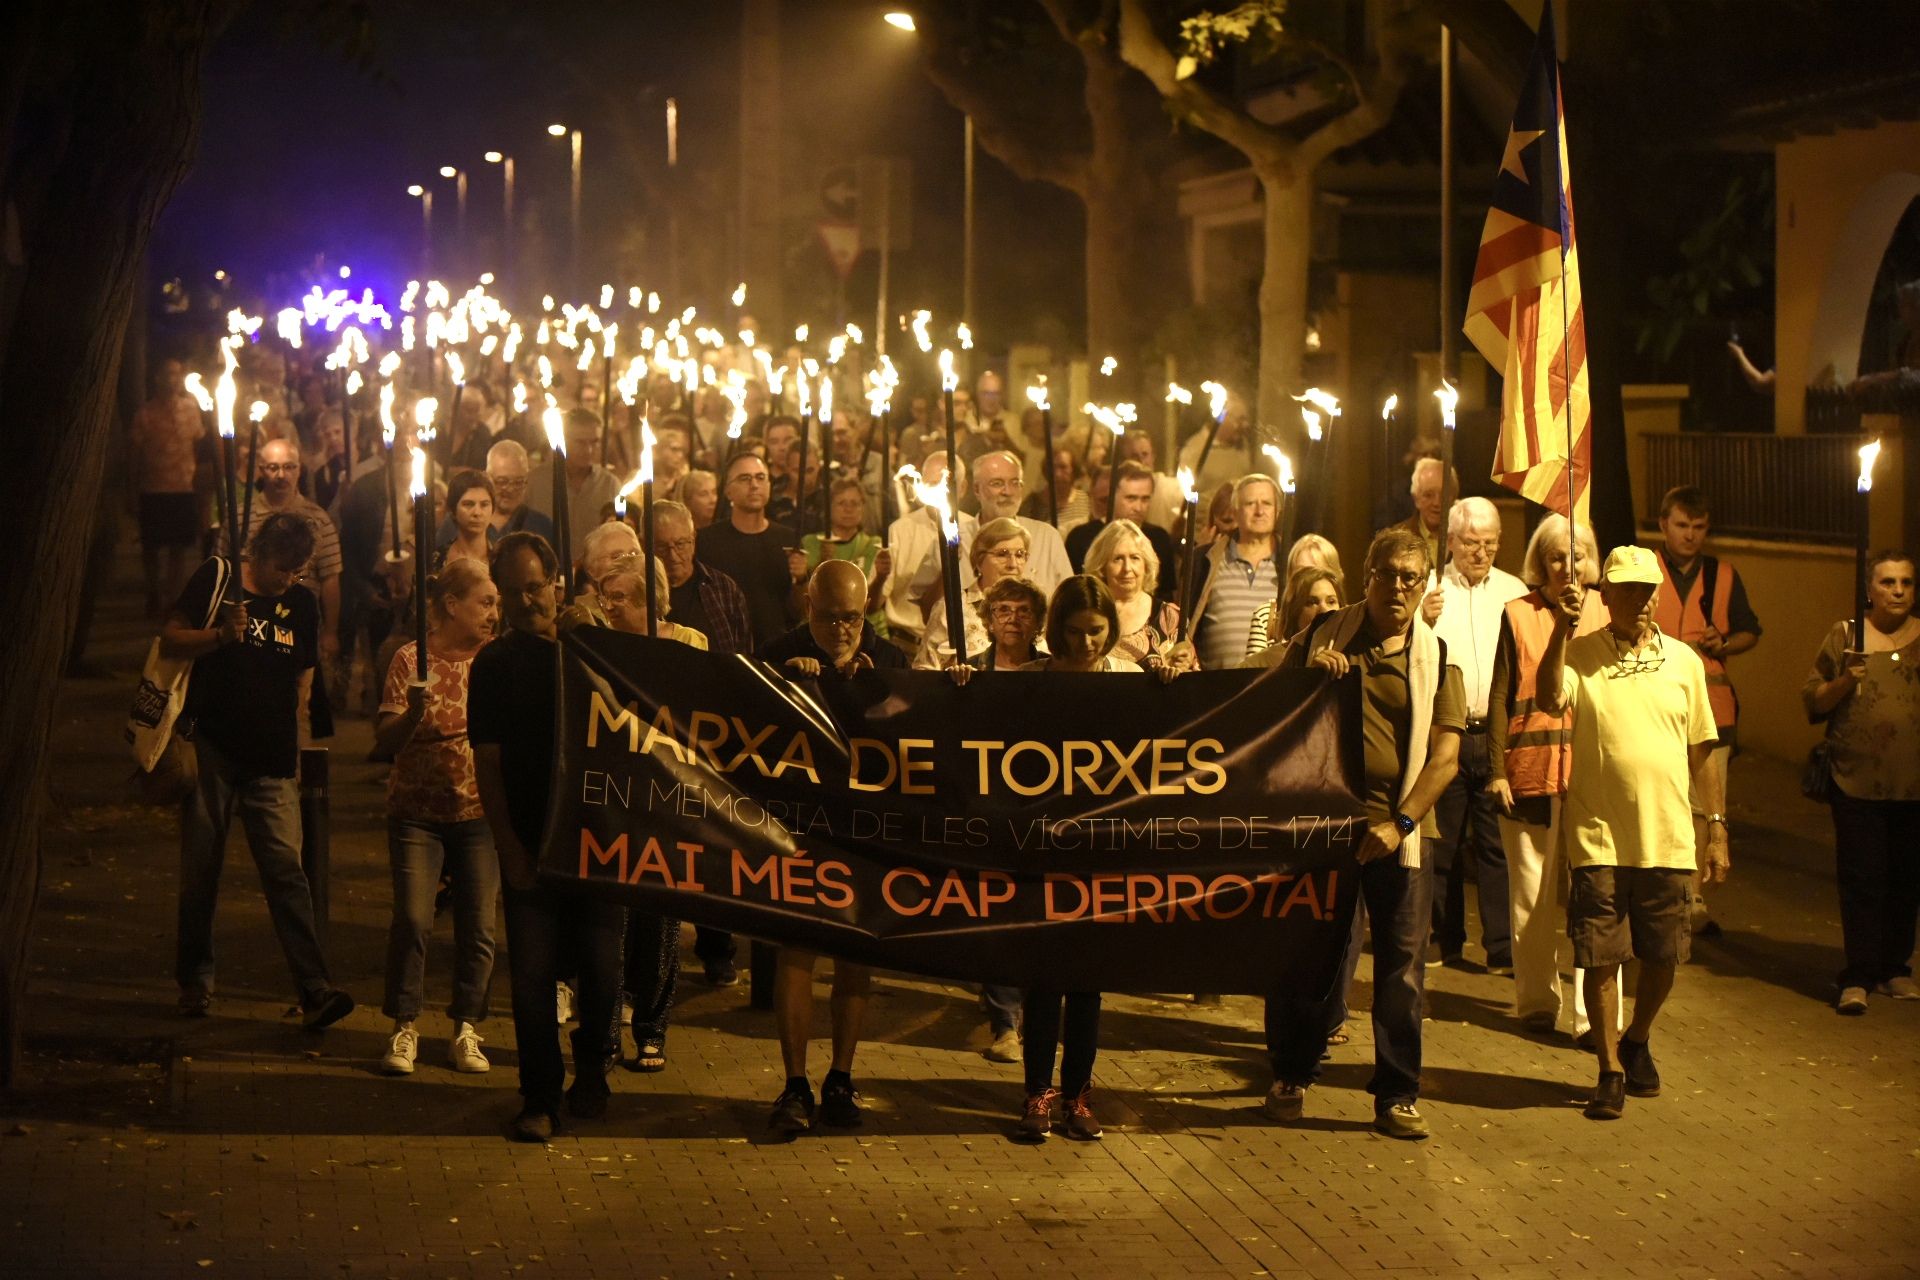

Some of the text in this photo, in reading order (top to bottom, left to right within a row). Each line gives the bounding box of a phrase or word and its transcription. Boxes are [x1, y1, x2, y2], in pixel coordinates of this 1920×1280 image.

[586, 690, 1227, 797] MARXA DE TORXES
[583, 769, 1353, 851] EN MEMORIA DE LES VÍCTIMES DE 1714
[578, 828, 1340, 924] MAI MÉS CAP DERROTA!
